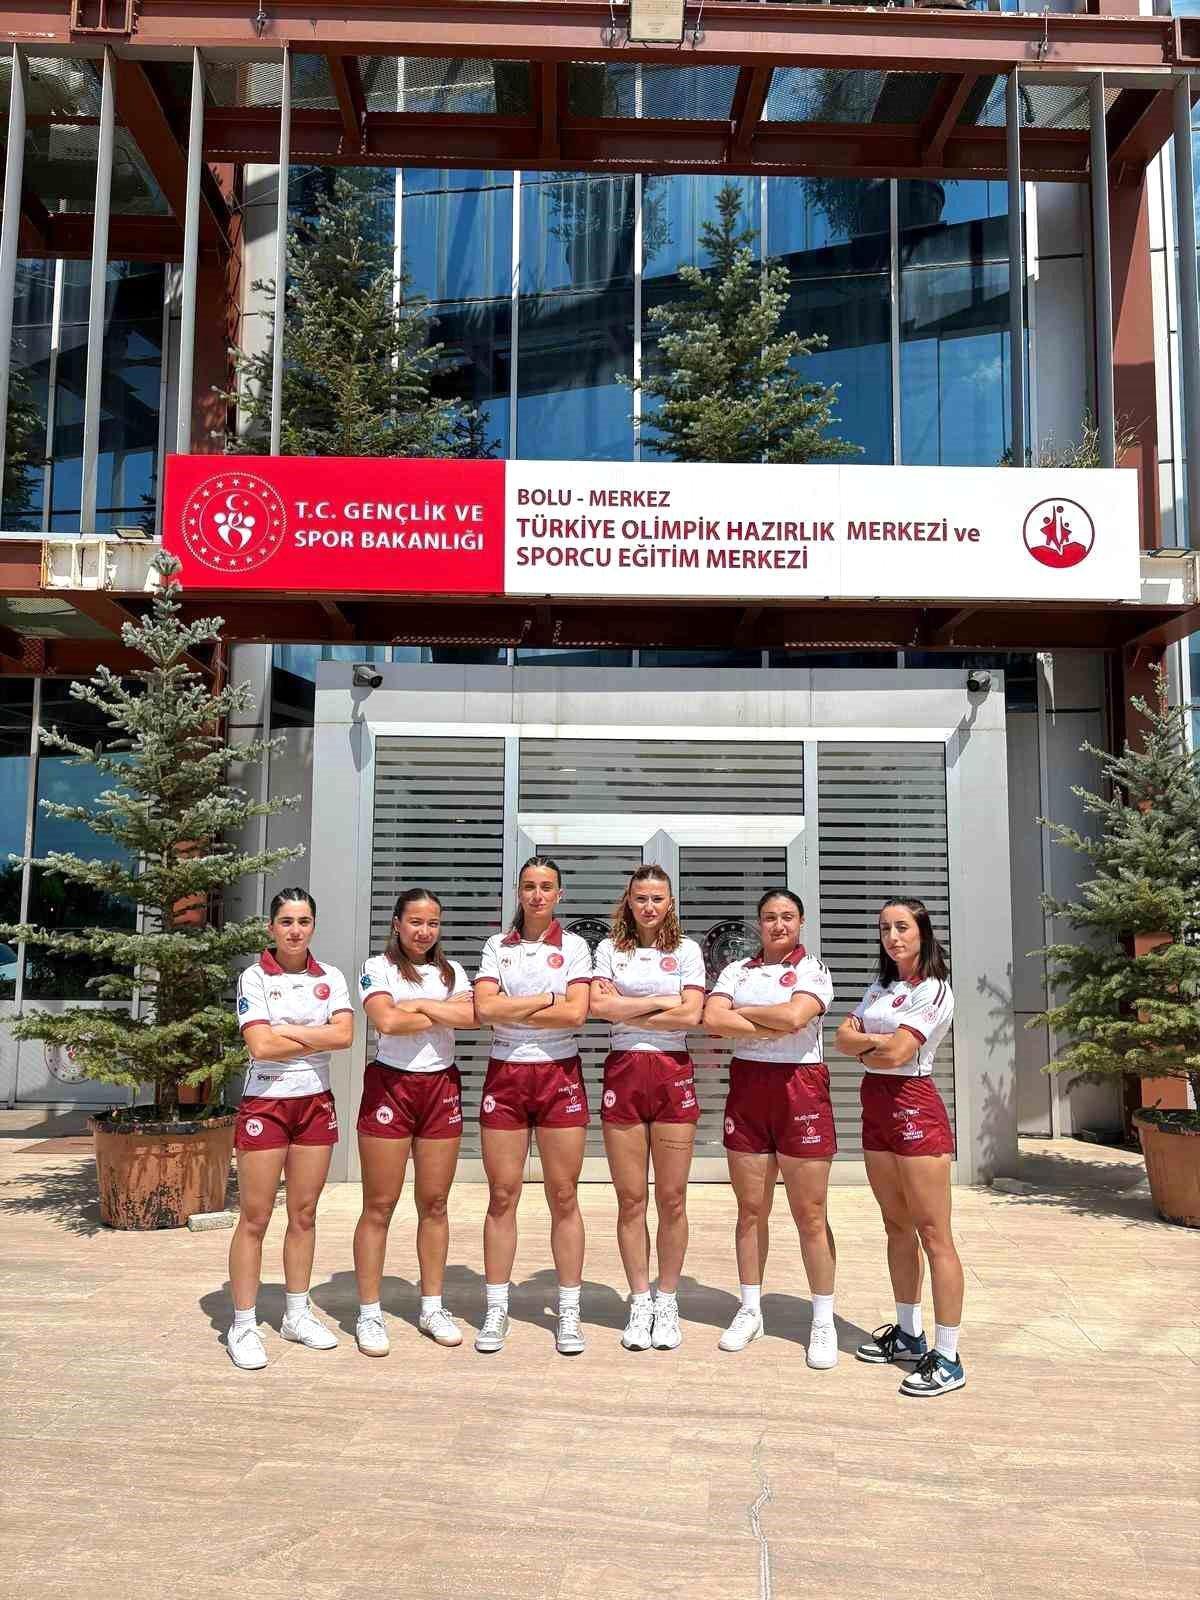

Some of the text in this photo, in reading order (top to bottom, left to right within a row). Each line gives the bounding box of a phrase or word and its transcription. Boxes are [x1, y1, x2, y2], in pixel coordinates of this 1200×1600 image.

[517, 488, 572, 506] BOLU
[589, 489, 671, 508] MERKEZ
[294, 500, 484, 526] T.C. GENÇLİK VE
[294, 529, 484, 552] SPOR BAKANLIĞI
[516, 513, 981, 543] TÜRKİYE OLİMPİK HAZIRLIK MERKEZİ ve
[516, 544, 809, 570] SPORCU EĞİTİM MERKEZİ
